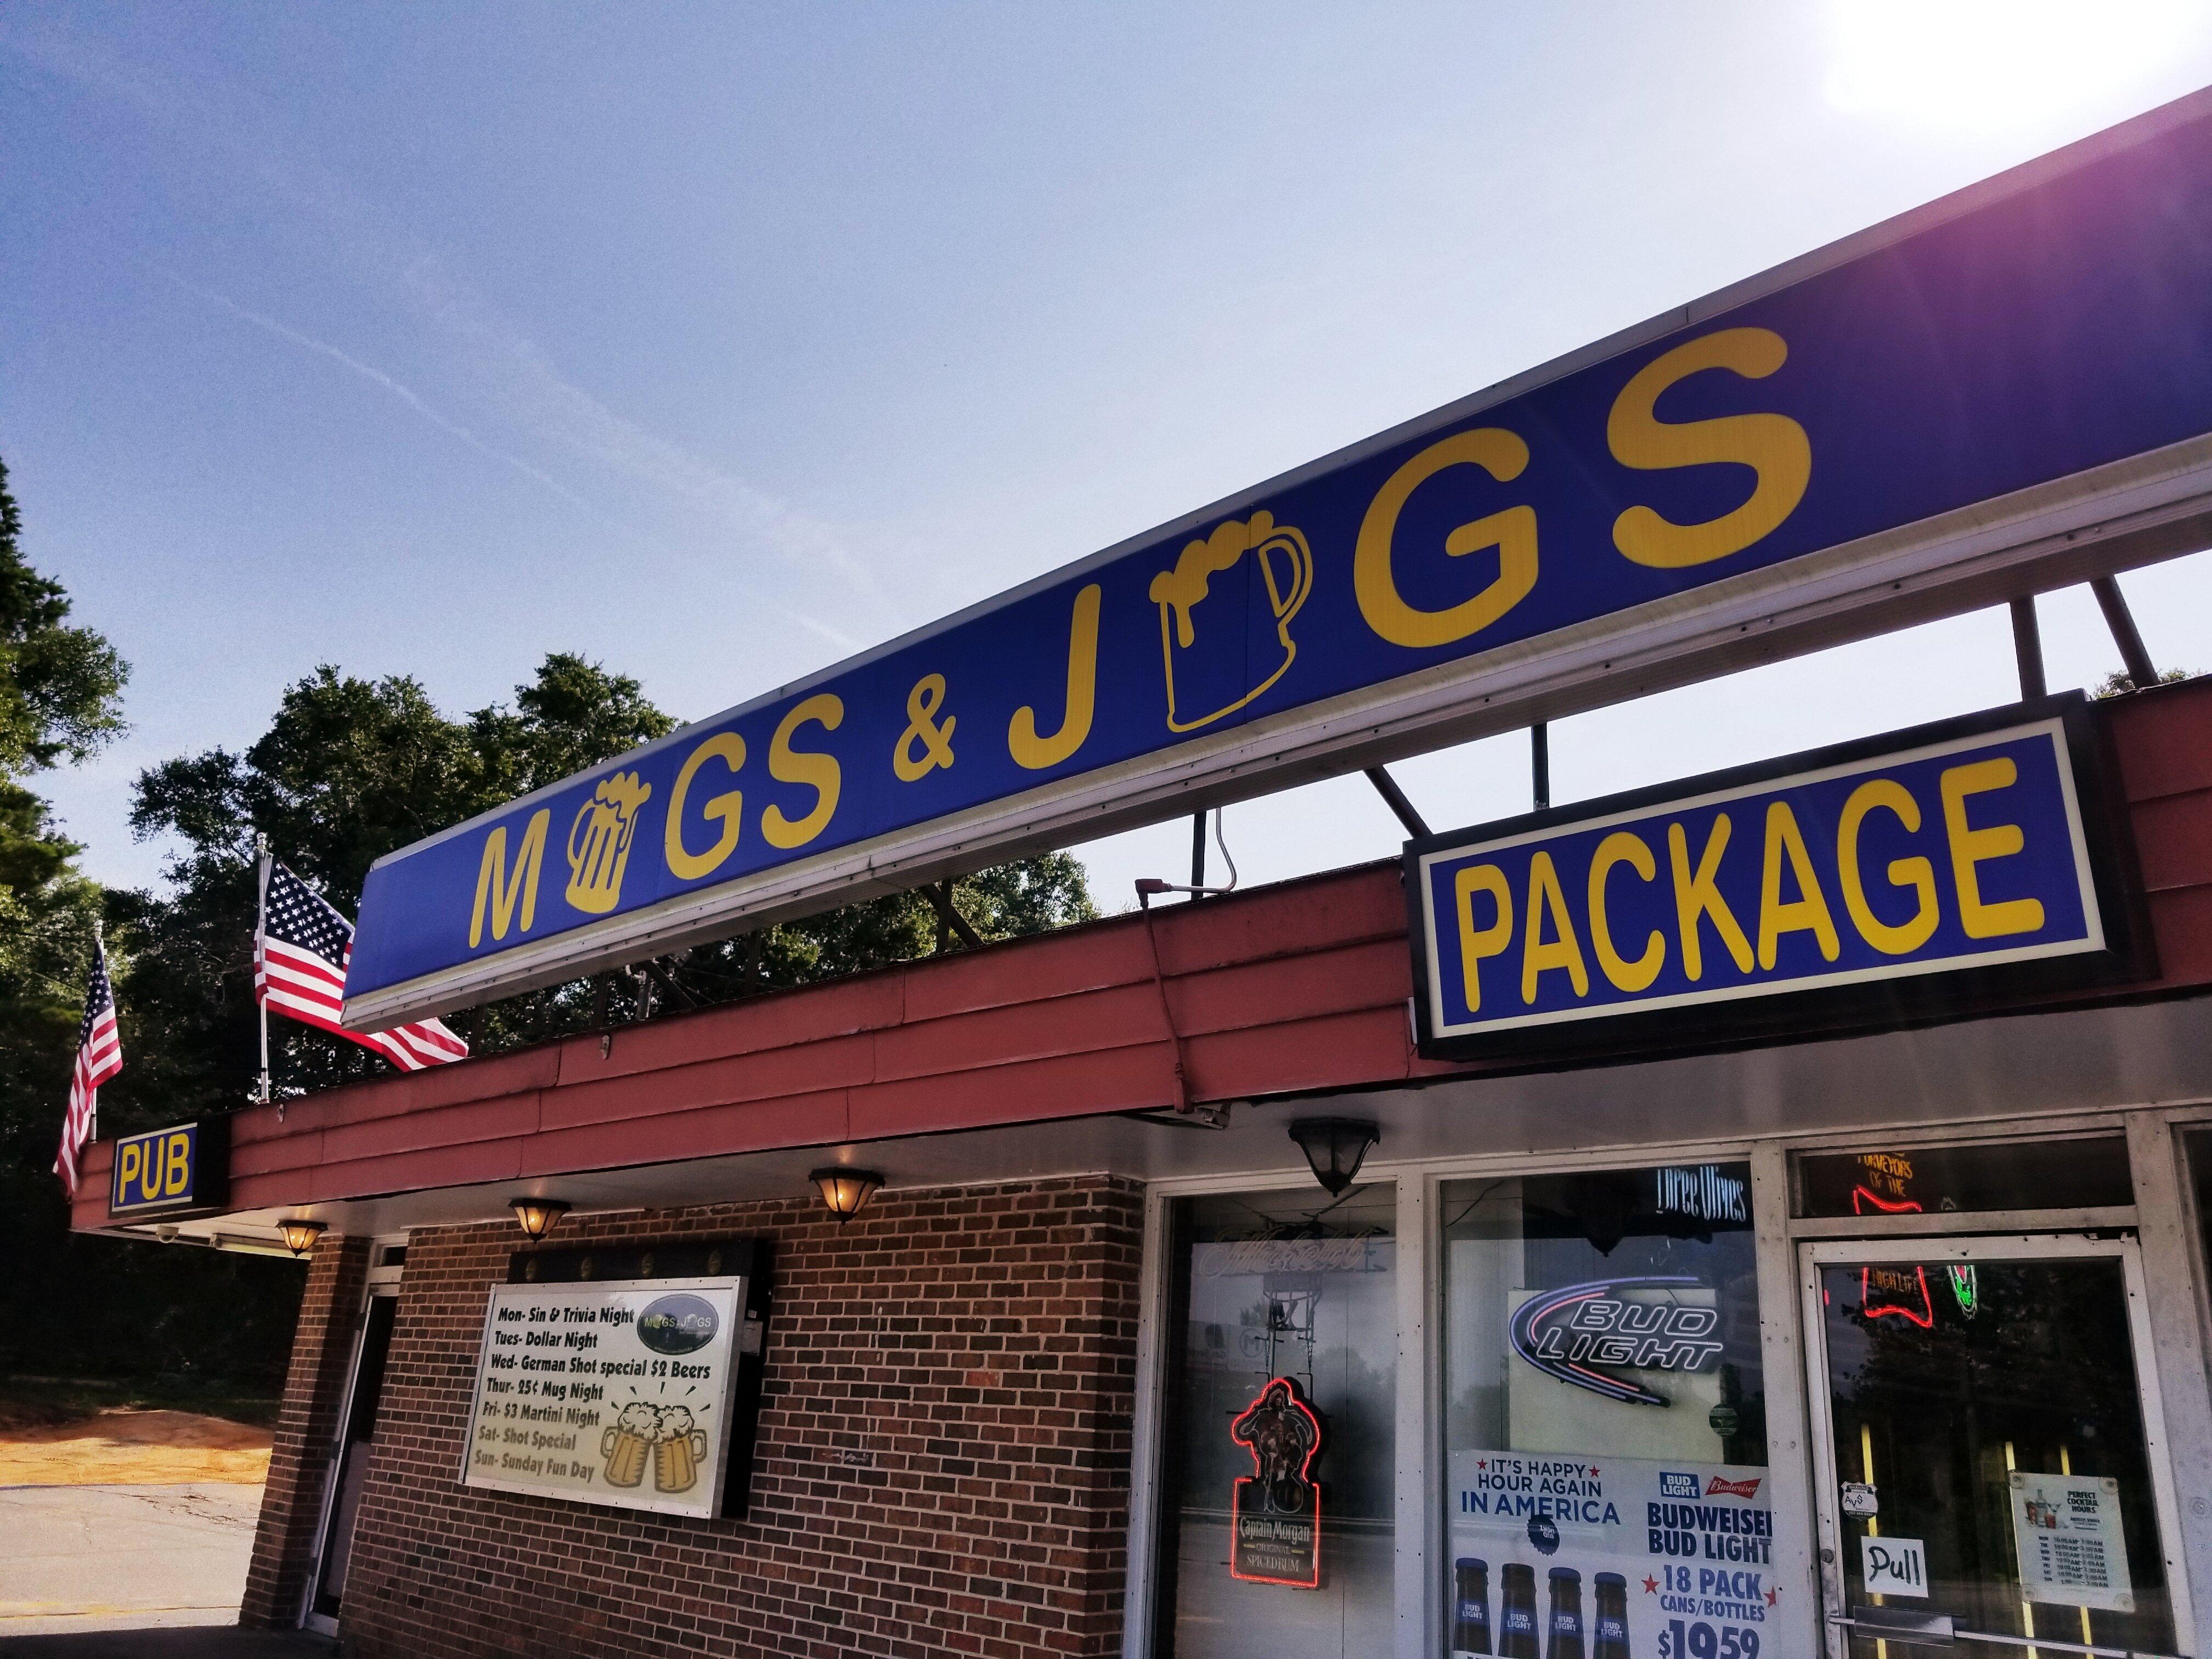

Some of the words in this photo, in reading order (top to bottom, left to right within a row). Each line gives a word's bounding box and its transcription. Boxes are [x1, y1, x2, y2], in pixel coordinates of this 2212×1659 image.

[469, 693, 844, 949] MGS
[893, 673, 957, 783] &
[1008, 326, 1812, 770] JGS
[1454, 757, 2045, 1012] PACKAGE
[119, 1133, 189, 1204] PUB
[498, 1307, 526, 1322] Mon-
[528, 1307, 546, 1323] Sin
[549, 1307, 560, 1323] &
[563, 1307, 596, 1323] Trivia
[600, 1307, 635, 1327] Night
[1570, 1299, 1718, 1336] BUD
[495, 1330, 522, 1345] Tues-
[526, 1331, 562, 1347] Dollar
[564, 1331, 598, 1351] Night
[1536, 1327, 1723, 1370] LIGHT
[491, 1353, 518, 1369] Wed-
[521, 1355, 566, 1372] German
[569, 1357, 597, 1374] Shot
[600, 1358, 646, 1378] special
[651, 1360, 667, 1378] $2
[671, 1361, 711, 1380] Beers
[487, 1377, 515, 1393] Thur-
[517, 1379, 539, 1395] 25¢
[541, 1381, 567, 1401] Mug
[570, 1382, 604, 1403] Night
[482, 1401, 501, 1417] Fri-
[504, 1402, 518, 1419] $3
[520, 1404, 563, 1423] Martini
[566, 1408, 600, 1429] Night
[478, 1425, 500, 1441] Sat-
[503, 1427, 529, 1445] Shot
[531, 1431, 577, 1451] Special
[475, 1449, 498, 1466] Sun-
[501, 1453, 543, 1476] Sunday
[546, 1458, 567, 1476] Fun
[570, 1461, 594, 1483] Day
[1491, 1459, 1522, 1475] IT'S
[1528, 1461, 1587, 1480] HAPPY
[1478, 1474, 1532, 1492] HOUR
[1540, 1478, 1602, 1497] AGAIN
[1662, 1485, 1697, 1497] LIGHT
[1666, 1475, 1691, 1486] BUD
[1711, 1480, 1758, 1493] Budweiser
[2067, 1498, 2099, 1506] COCKTAIL
[2068, 1490, 2096, 1499] PERFECT
[1462, 1491, 1488, 1514] IN
[1494, 1495, 1622, 1526] AMERICA
[1240, 1517, 1272, 1539] Captain
[1272, 1521, 1310, 1544] Morgan
[1648, 1528, 1697, 1557] BUD
[1705, 1533, 1771, 1564] LIGHT
[1278, 1558, 1300, 1572] RUM
[1869, 1546, 1920, 1585] Pull
[1663, 1564, 1691, 1593] 18
[1699, 1568, 1763, 1600] PACK
[1462, 1610, 1483, 1619] LIGHT
[1465, 1604, 1480, 1612] BUD
[1510, 1613, 1528, 1622] BUD
[1558, 1615, 1574, 1623] BUD
[1660, 1594, 1765, 1622] CANS/BOTTLES
[1508, 1620, 1531, 1630] LIGHT
[1555, 1622, 1577, 1632] LIGHT
[1601, 1628, 1623, 1638] LIGHT
[1604, 1621, 1621, 1630] BUD
